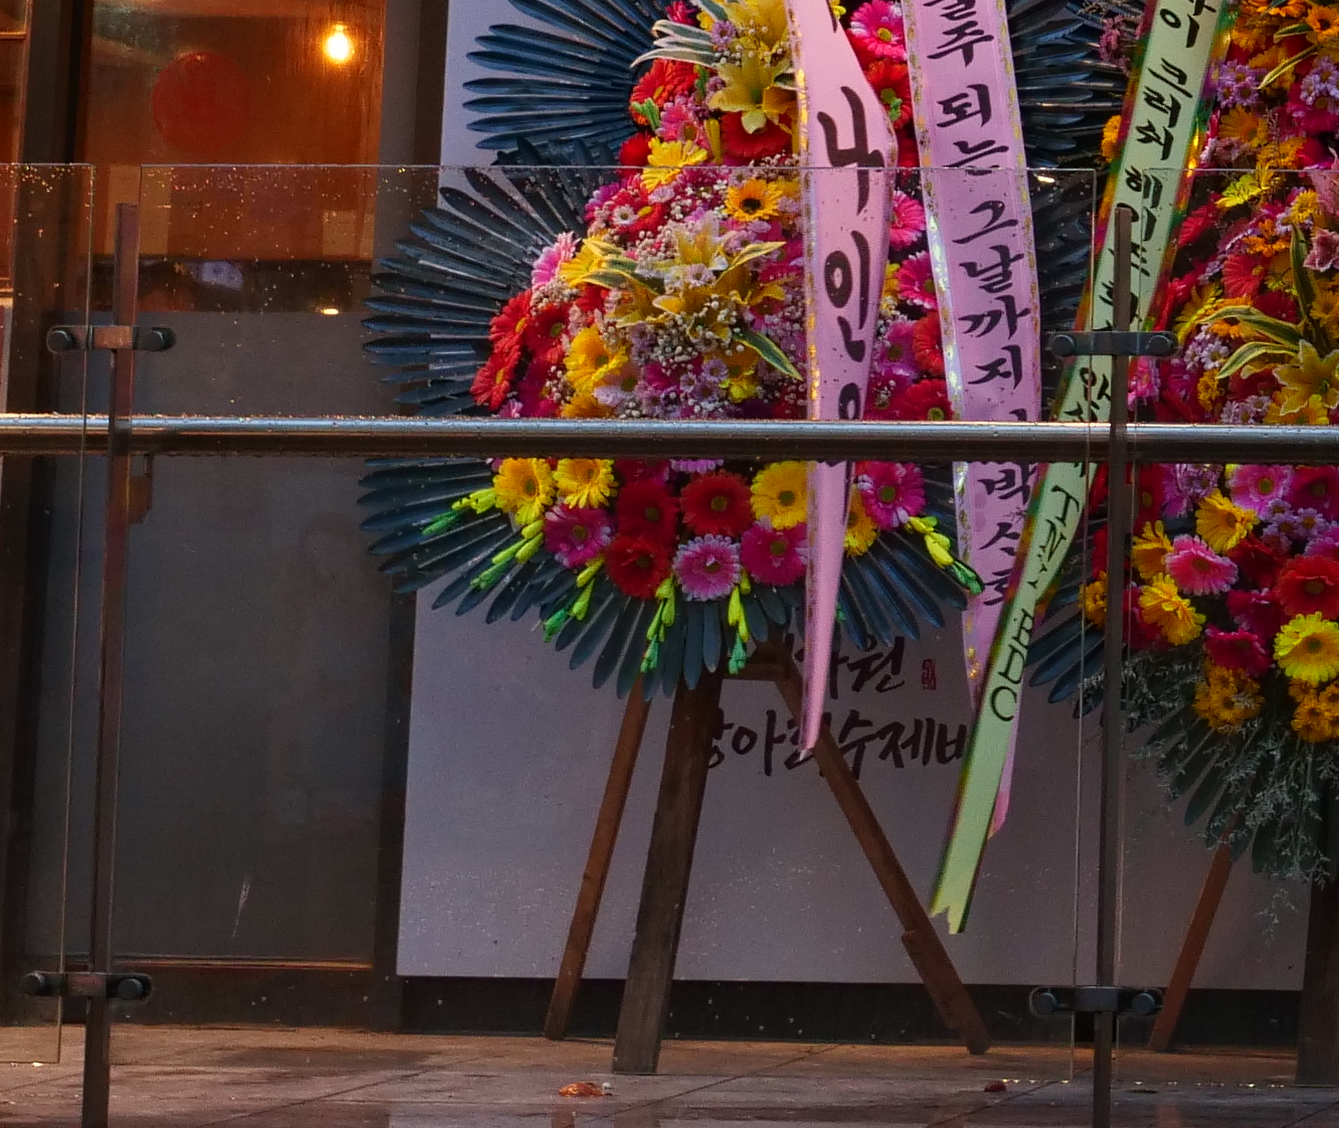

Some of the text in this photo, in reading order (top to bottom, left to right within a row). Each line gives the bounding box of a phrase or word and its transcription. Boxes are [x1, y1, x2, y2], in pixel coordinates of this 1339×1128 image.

[936, 83, 1010, 177] 되는
[1136, 57, 1193, 161] 크러쉬
[952, 200, 1032, 391] 그날까지
